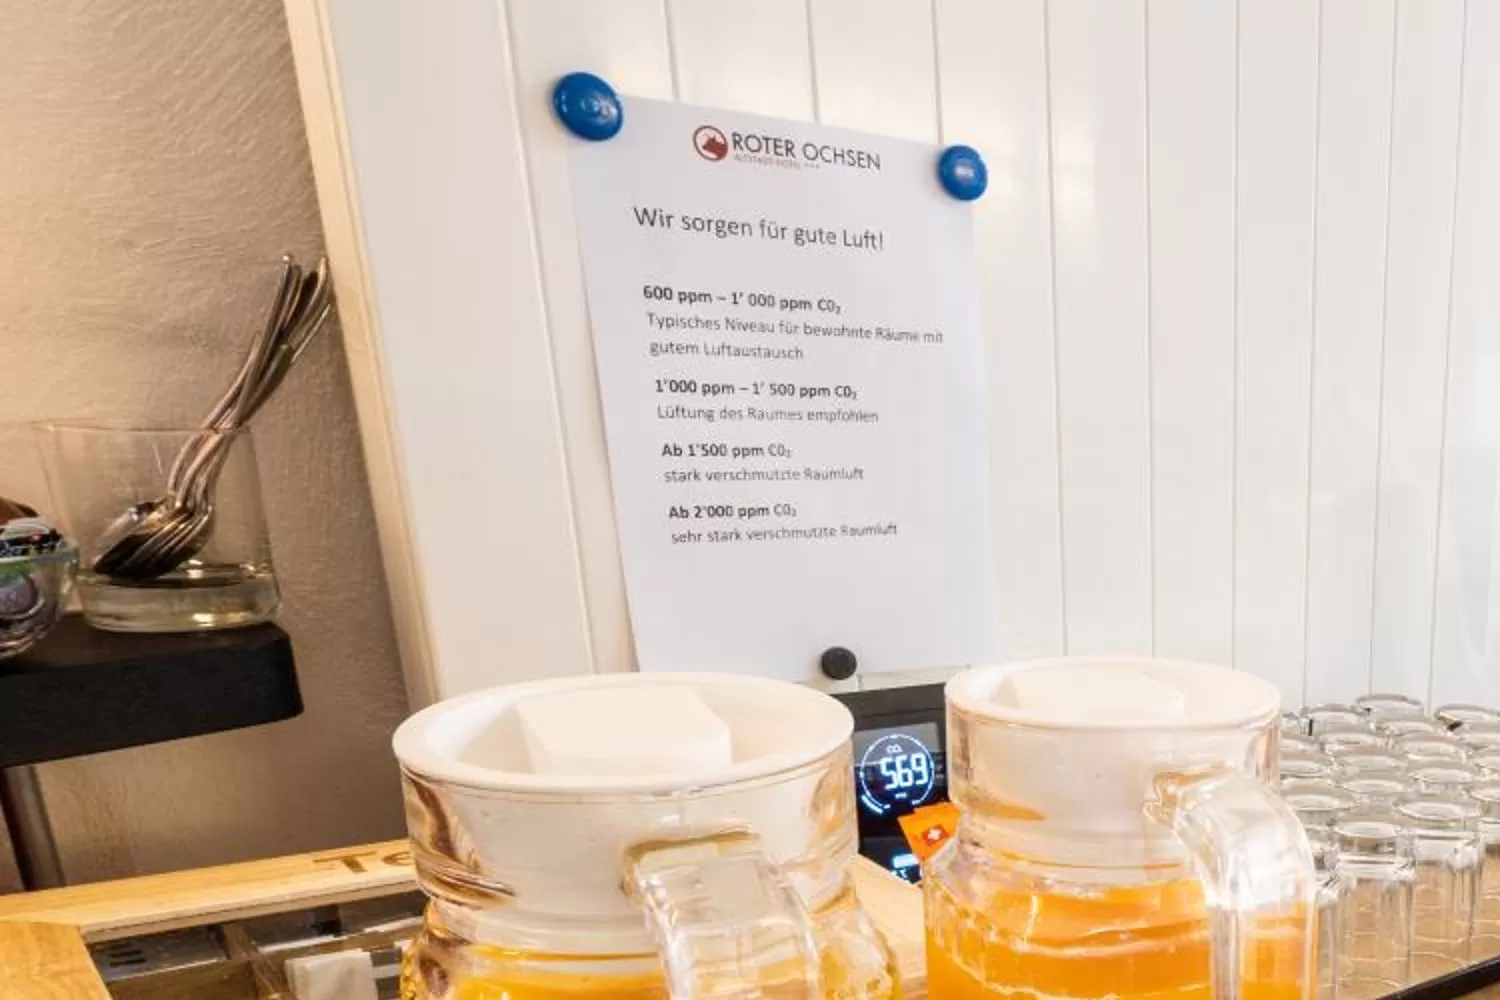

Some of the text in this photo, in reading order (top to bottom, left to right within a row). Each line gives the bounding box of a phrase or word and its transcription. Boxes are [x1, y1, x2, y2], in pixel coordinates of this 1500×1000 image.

[731, 131, 796, 158] ROTER
[802, 142, 881, 171] OCHSEN
[633, 207, 884, 251] Wir sorgen für gute Luft!
[643, 285, 674, 301] 600
[677, 291, 713, 305] ppm
[779, 298, 813, 312] ppm
[648, 312, 721, 331] Typisches
[724, 317, 775, 333] Niveau
[778, 319, 800, 335] für
[803, 322, 873, 340] bewohnte
[649, 341, 804, 360] gutem Luftaustausch
[655, 379, 697, 394] 1'000
[701, 383, 735, 397] ppm
[799, 386, 831, 400] ppm
[657, 404, 879, 424] Lüftung des Raumes empfohlen
[661, 442, 683, 458] Ab
[688, 443, 728, 458] 1'500
[731, 446, 765, 460] ppm
[664, 466, 864, 483] stark verschmutzte Raumluft
[669, 504, 690, 519] Ab
[693, 504, 734, 519] 2'000
[738, 505, 770, 520] ppm
[671, 521, 897, 545] sehr stark verschmutzte Raumluft
[881, 752, 929, 789] 569
